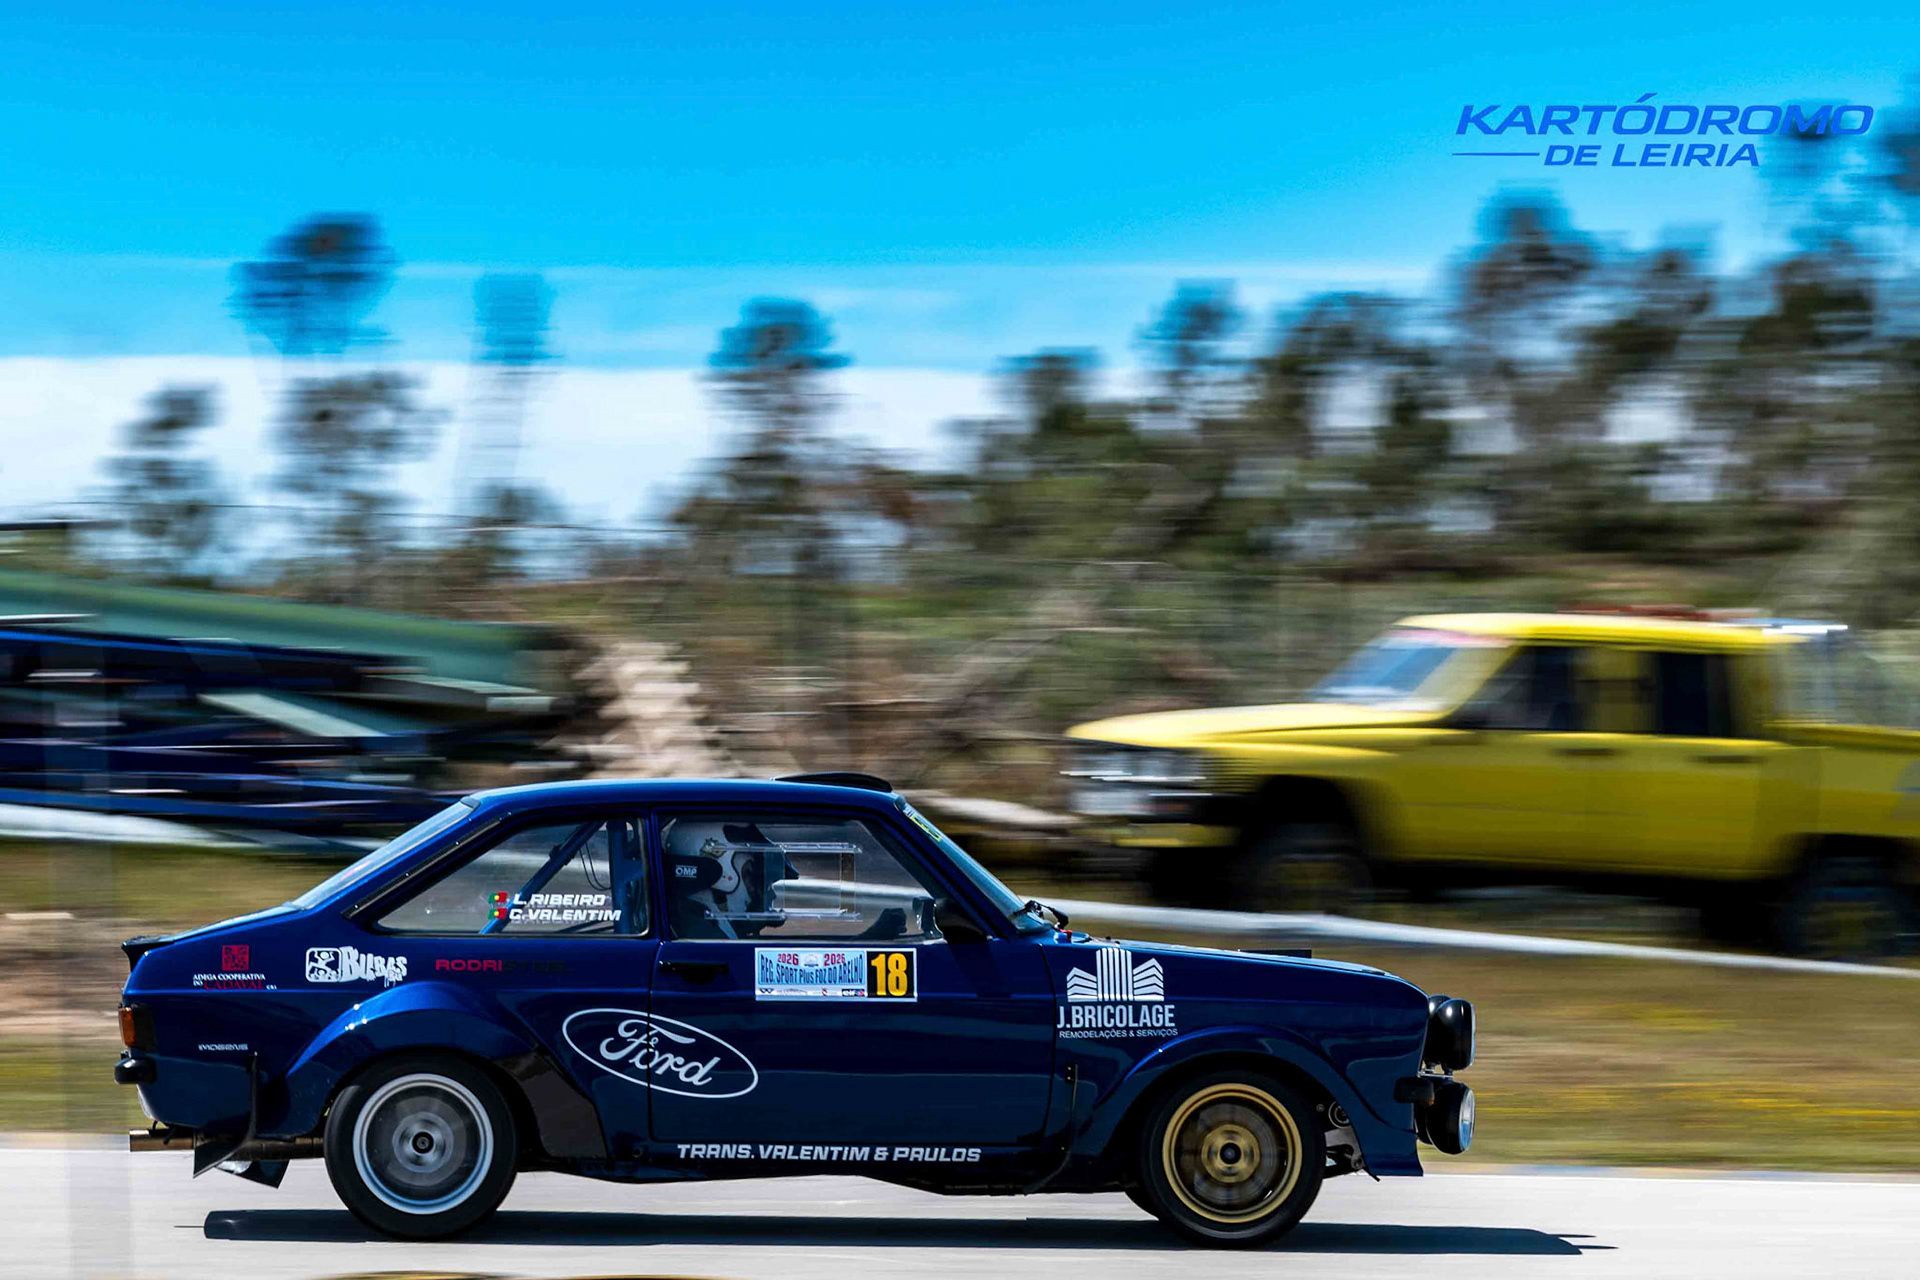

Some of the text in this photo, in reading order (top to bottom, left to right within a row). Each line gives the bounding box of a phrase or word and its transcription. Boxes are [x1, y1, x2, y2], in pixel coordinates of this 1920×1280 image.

[675, 866, 697, 877] OMP
[777, 953, 799, 966] 2026
[824, 953, 846, 966] 2026
[871, 953, 908, 997] 18
[1059, 1028, 1179, 1039] REMODELAÇÕES & SERVIÇOS
[600, 1019, 721, 1086] Ford
[873, 1147, 889, 1161] &
[892, 1147, 982, 1162] PAULOS
